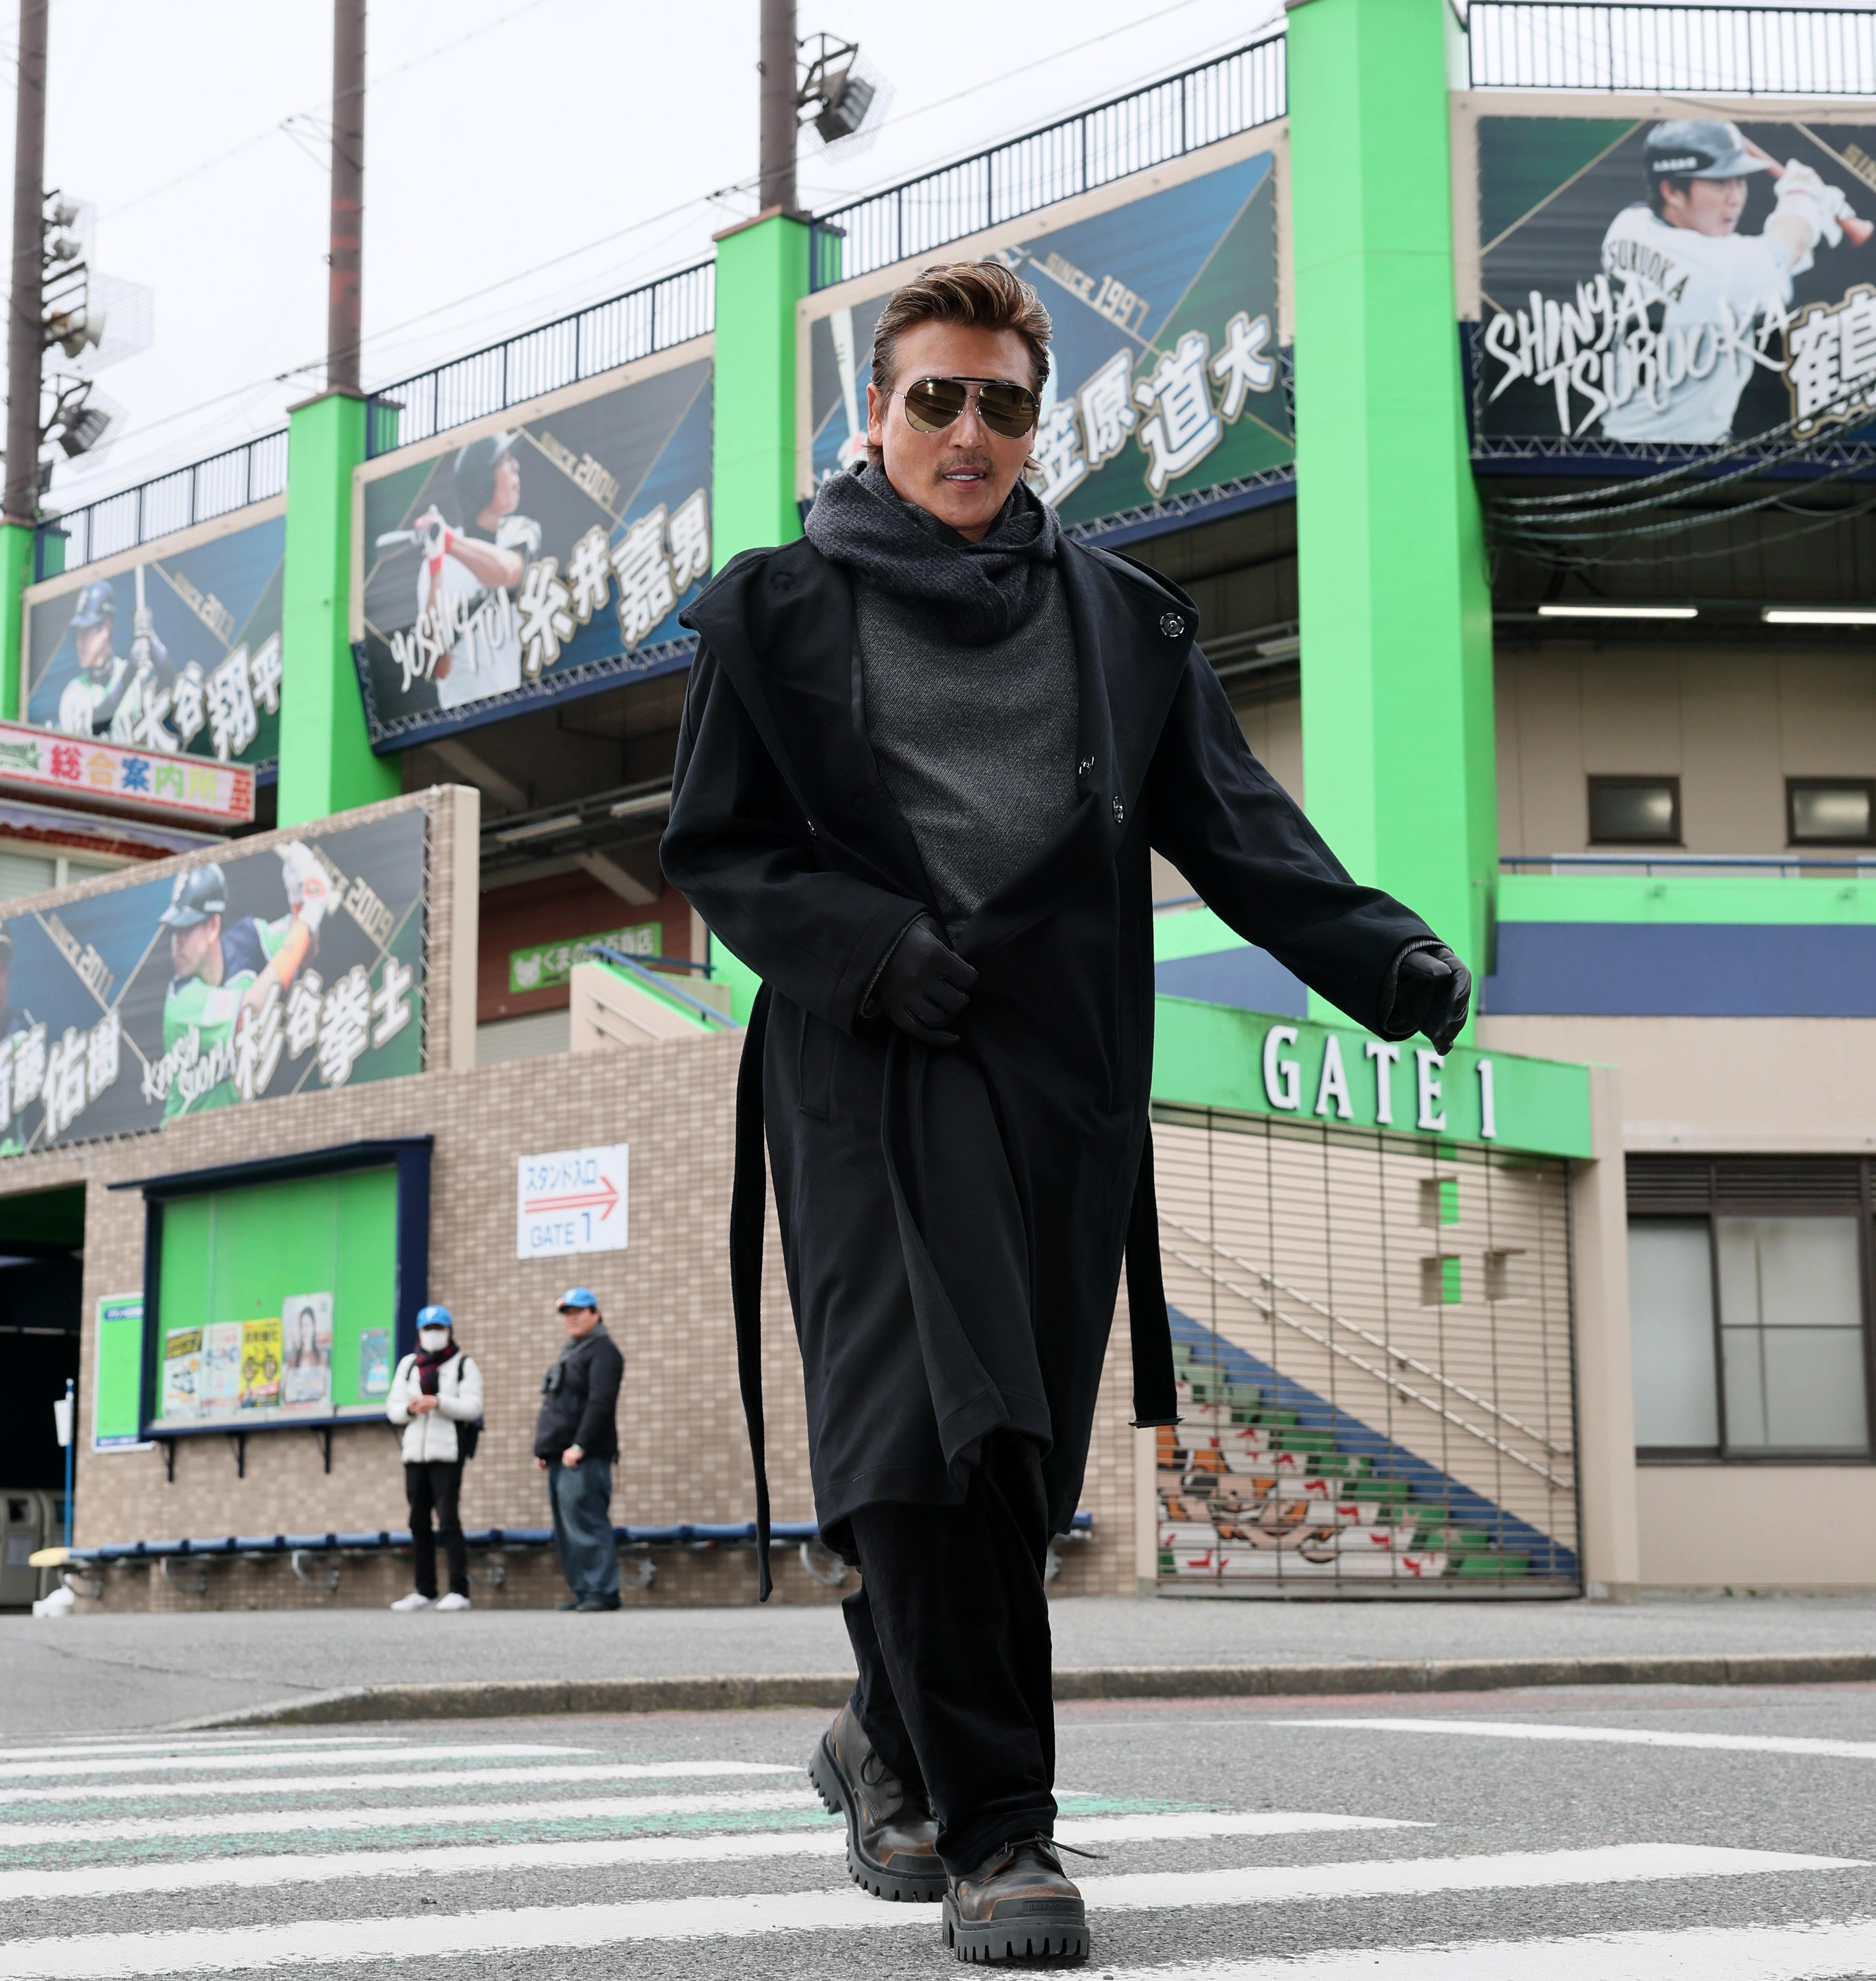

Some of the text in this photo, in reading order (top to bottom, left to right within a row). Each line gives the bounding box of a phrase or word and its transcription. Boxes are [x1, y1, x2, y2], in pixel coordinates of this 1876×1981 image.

[1093, 274, 1150, 335] 1997
[1484, 268, 1666, 403] SHINYA
[574, 451, 620, 511] 2004
[516, 488, 711, 676] 糸井嘉男
[132, 632, 282, 764] 大谷翔平
[50, 744, 219, 805] 総合案内所
[345, 876, 395, 946] 2009
[77, 943, 114, 1000] 2011
[233, 957, 413, 1101] 杉谷拳士
[1263, 1025, 1497, 1138] GATE 1
[525, 1158, 597, 1191] スタンド入口
[530, 1212, 590, 1248] GATE 1
